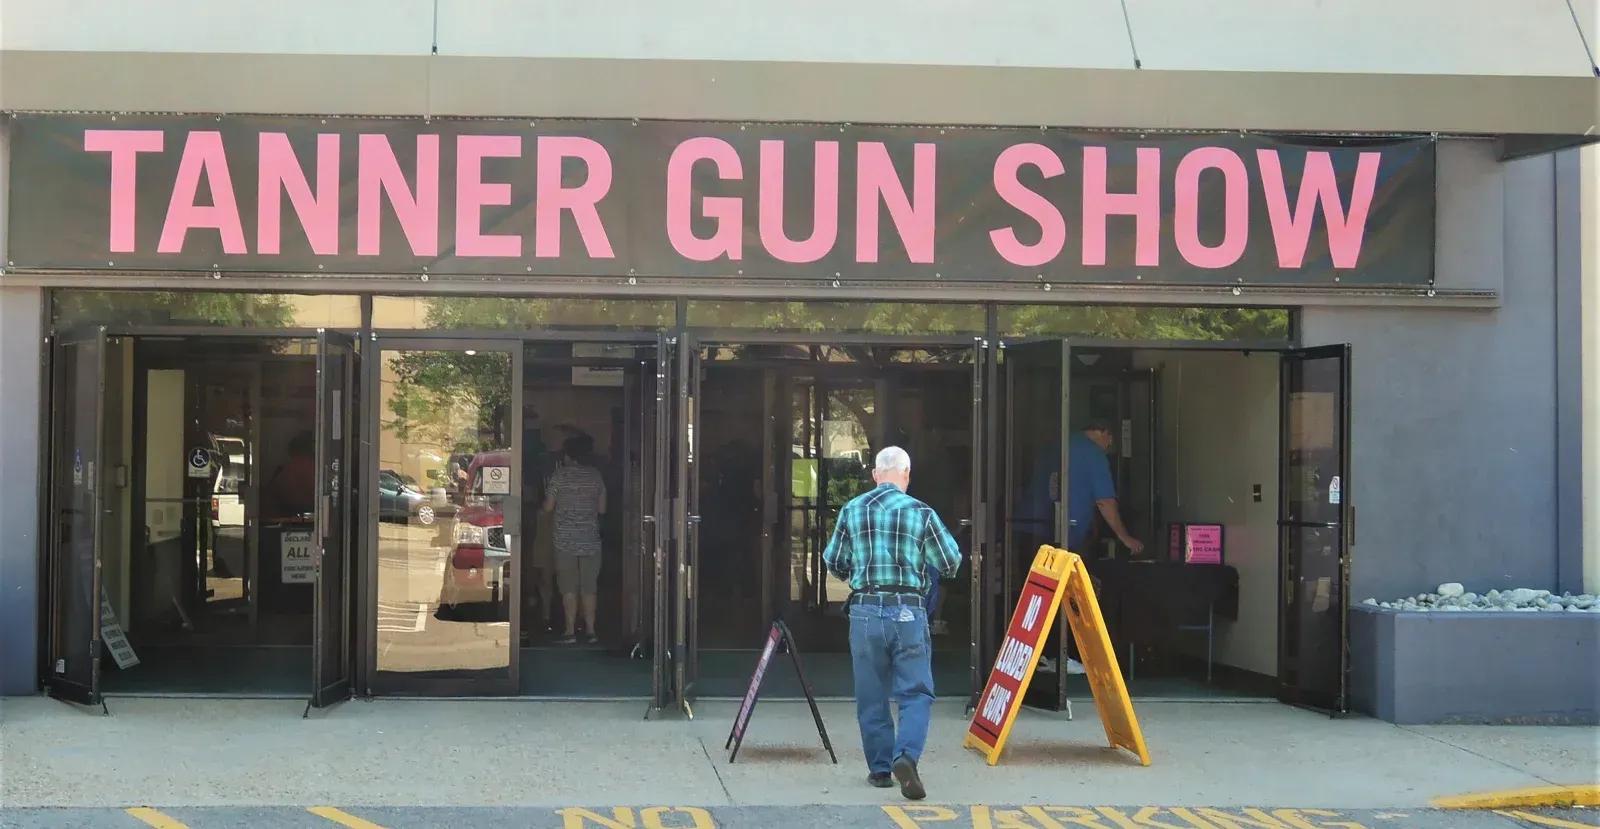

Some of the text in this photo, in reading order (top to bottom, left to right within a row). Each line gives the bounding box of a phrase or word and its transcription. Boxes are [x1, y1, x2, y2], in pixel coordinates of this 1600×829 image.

[84, 130, 1382, 269] TANNER GUN SHOW
[286, 547, 311, 559] ALL
[1021, 594, 1043, 632] NO
[996, 635, 1034, 682] LOADED
[982, 683, 1012, 726] GUNS
